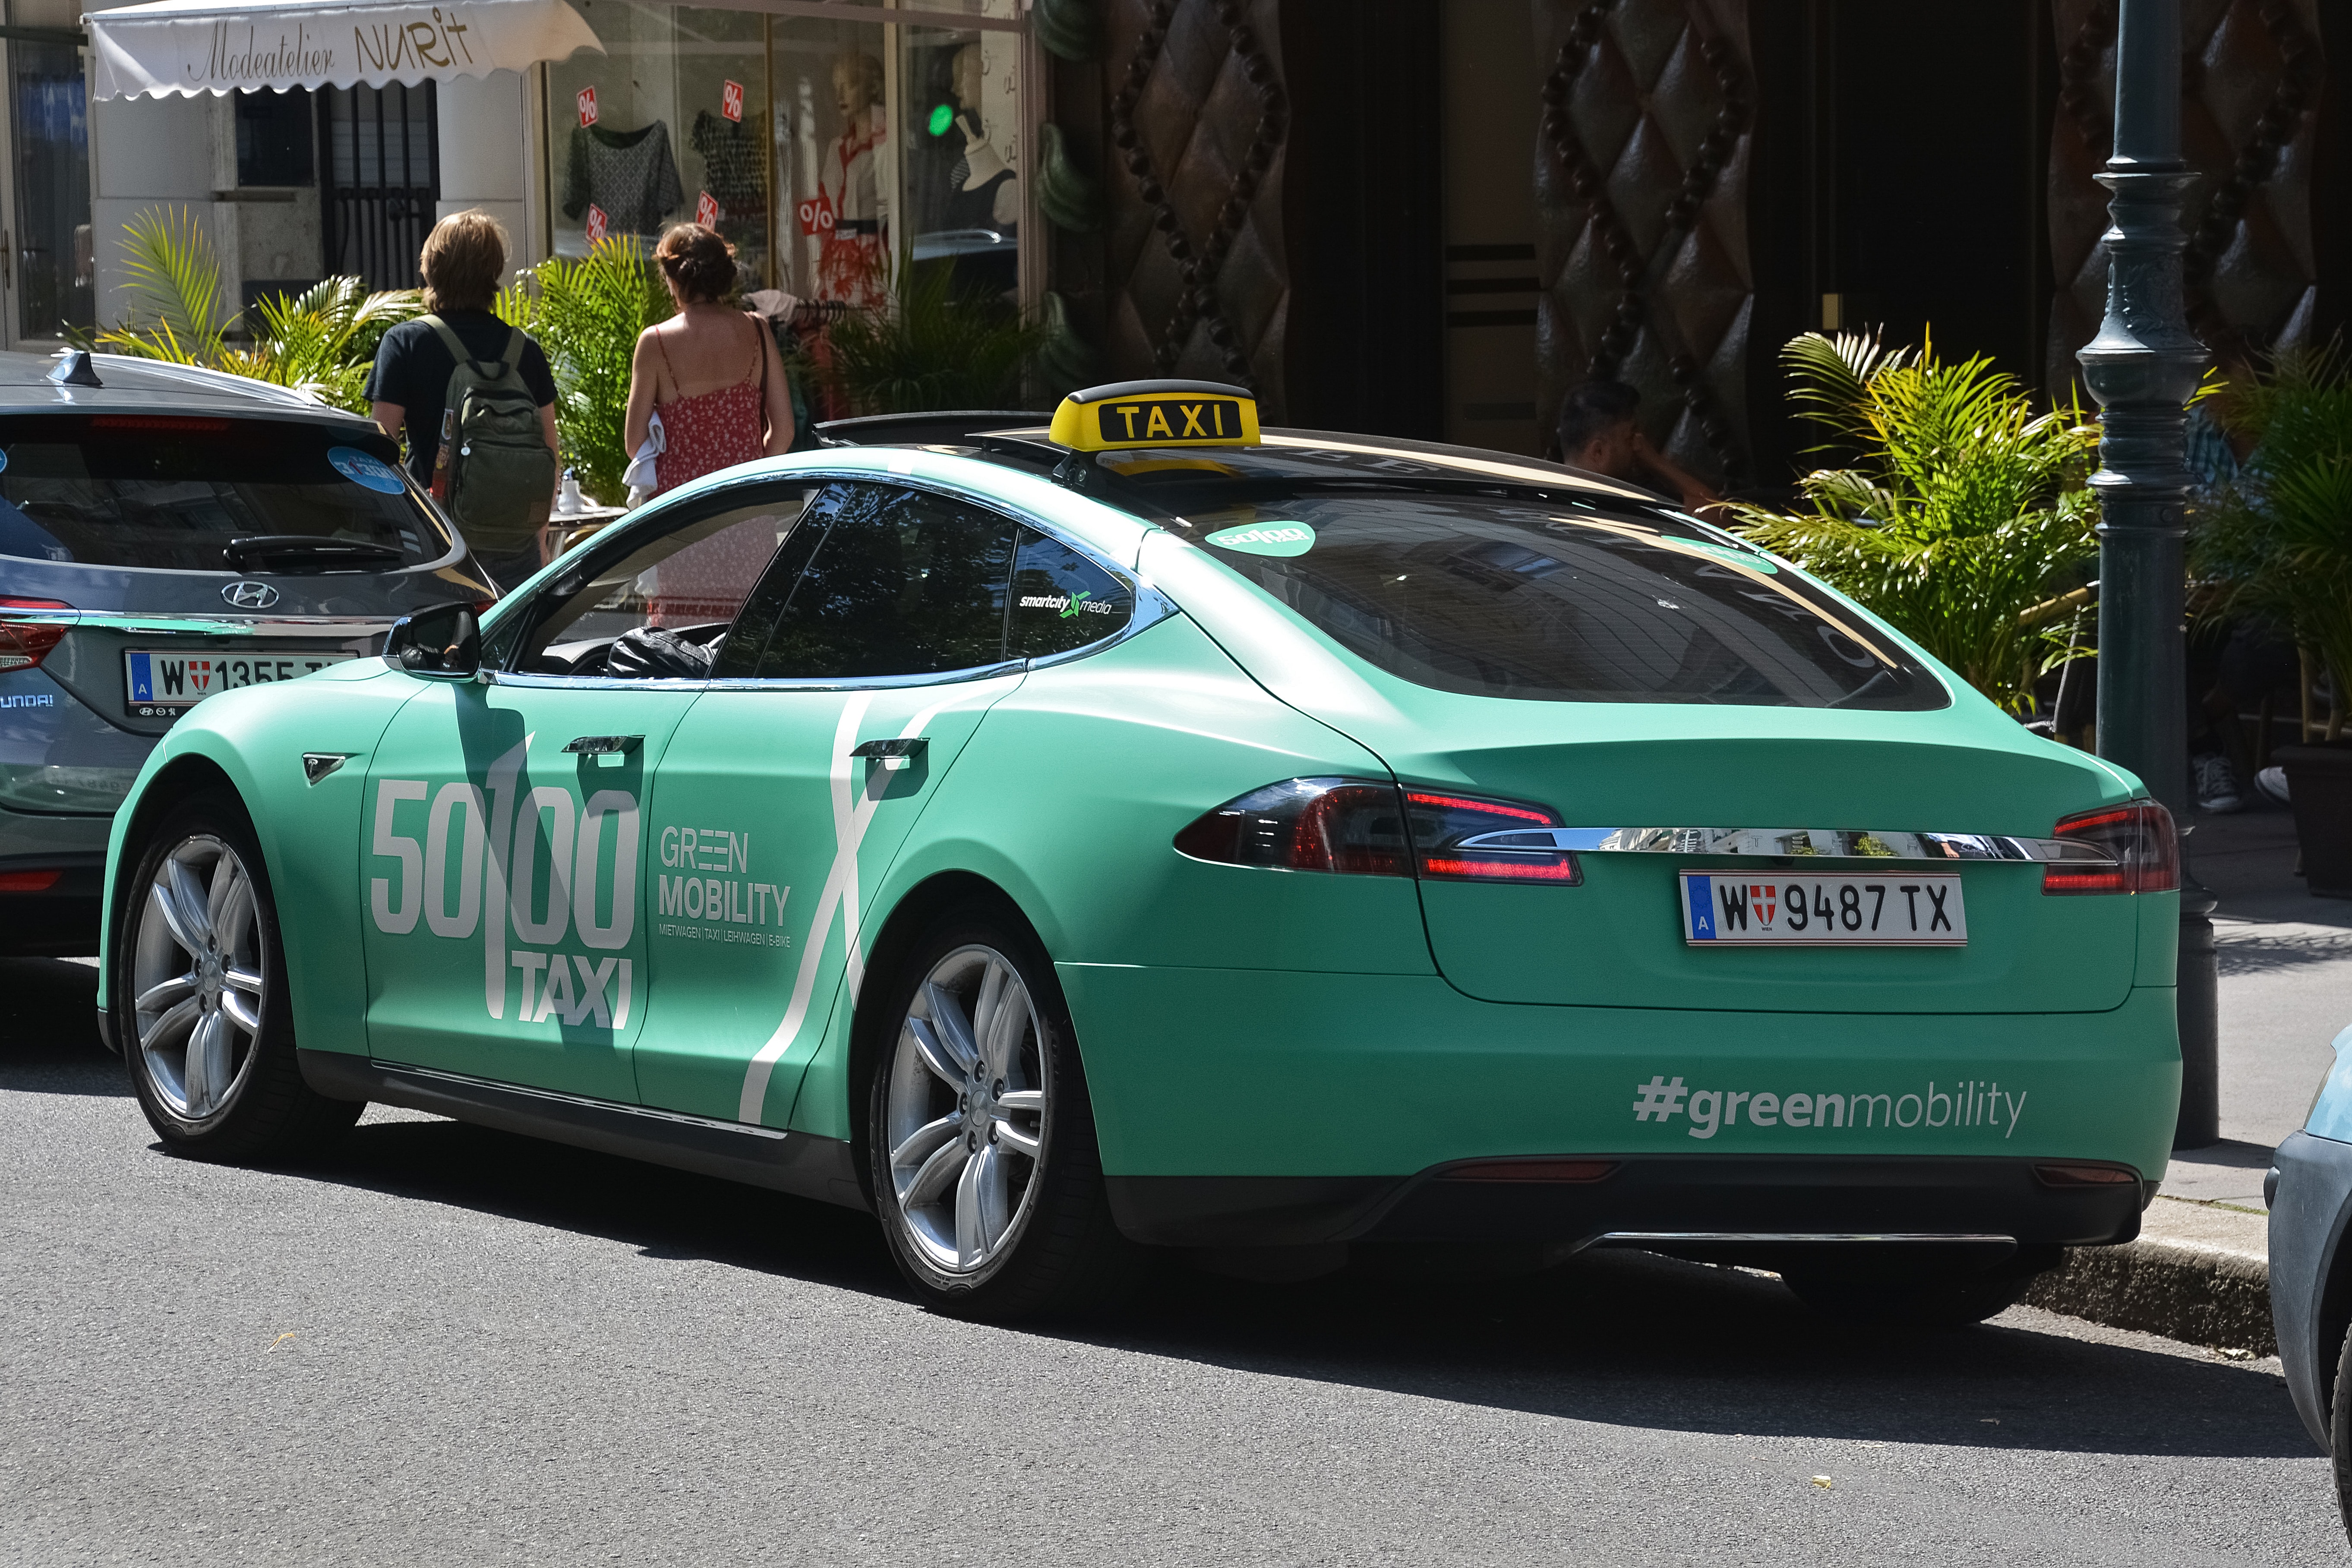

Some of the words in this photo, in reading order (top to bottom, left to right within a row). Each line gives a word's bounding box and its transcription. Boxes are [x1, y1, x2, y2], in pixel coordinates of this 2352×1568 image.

[188, 19, 335, 82] Modeatelier
[578, 91, 596, 123] %
[725, 85, 741, 118] %
[800, 201, 833, 232] %
[1117, 404, 1223, 438] TAXI
[137, 683, 147, 694] A
[160, 660, 184, 696] W
[215, 661, 294, 691] 1355
[660, 826, 748, 874] GREEN
[371, 730, 640, 1019] 50100
[659, 874, 791, 927] MOBILITY
[1719, 884, 1747, 931] W
[1784, 884, 1886, 932] 9487
[1899, 885, 1951, 932] TX
[659, 923, 701, 939] MIETWAGEN
[704, 928, 720, 941] TAXI
[724, 930, 765, 946] LEIHWAGEN
[769, 934, 790, 948] E-BIKE
[1698, 916, 1709, 931] A
[511, 950, 632, 1030] TAXI
[1632, 1075, 2027, 1139] #greenmobility
